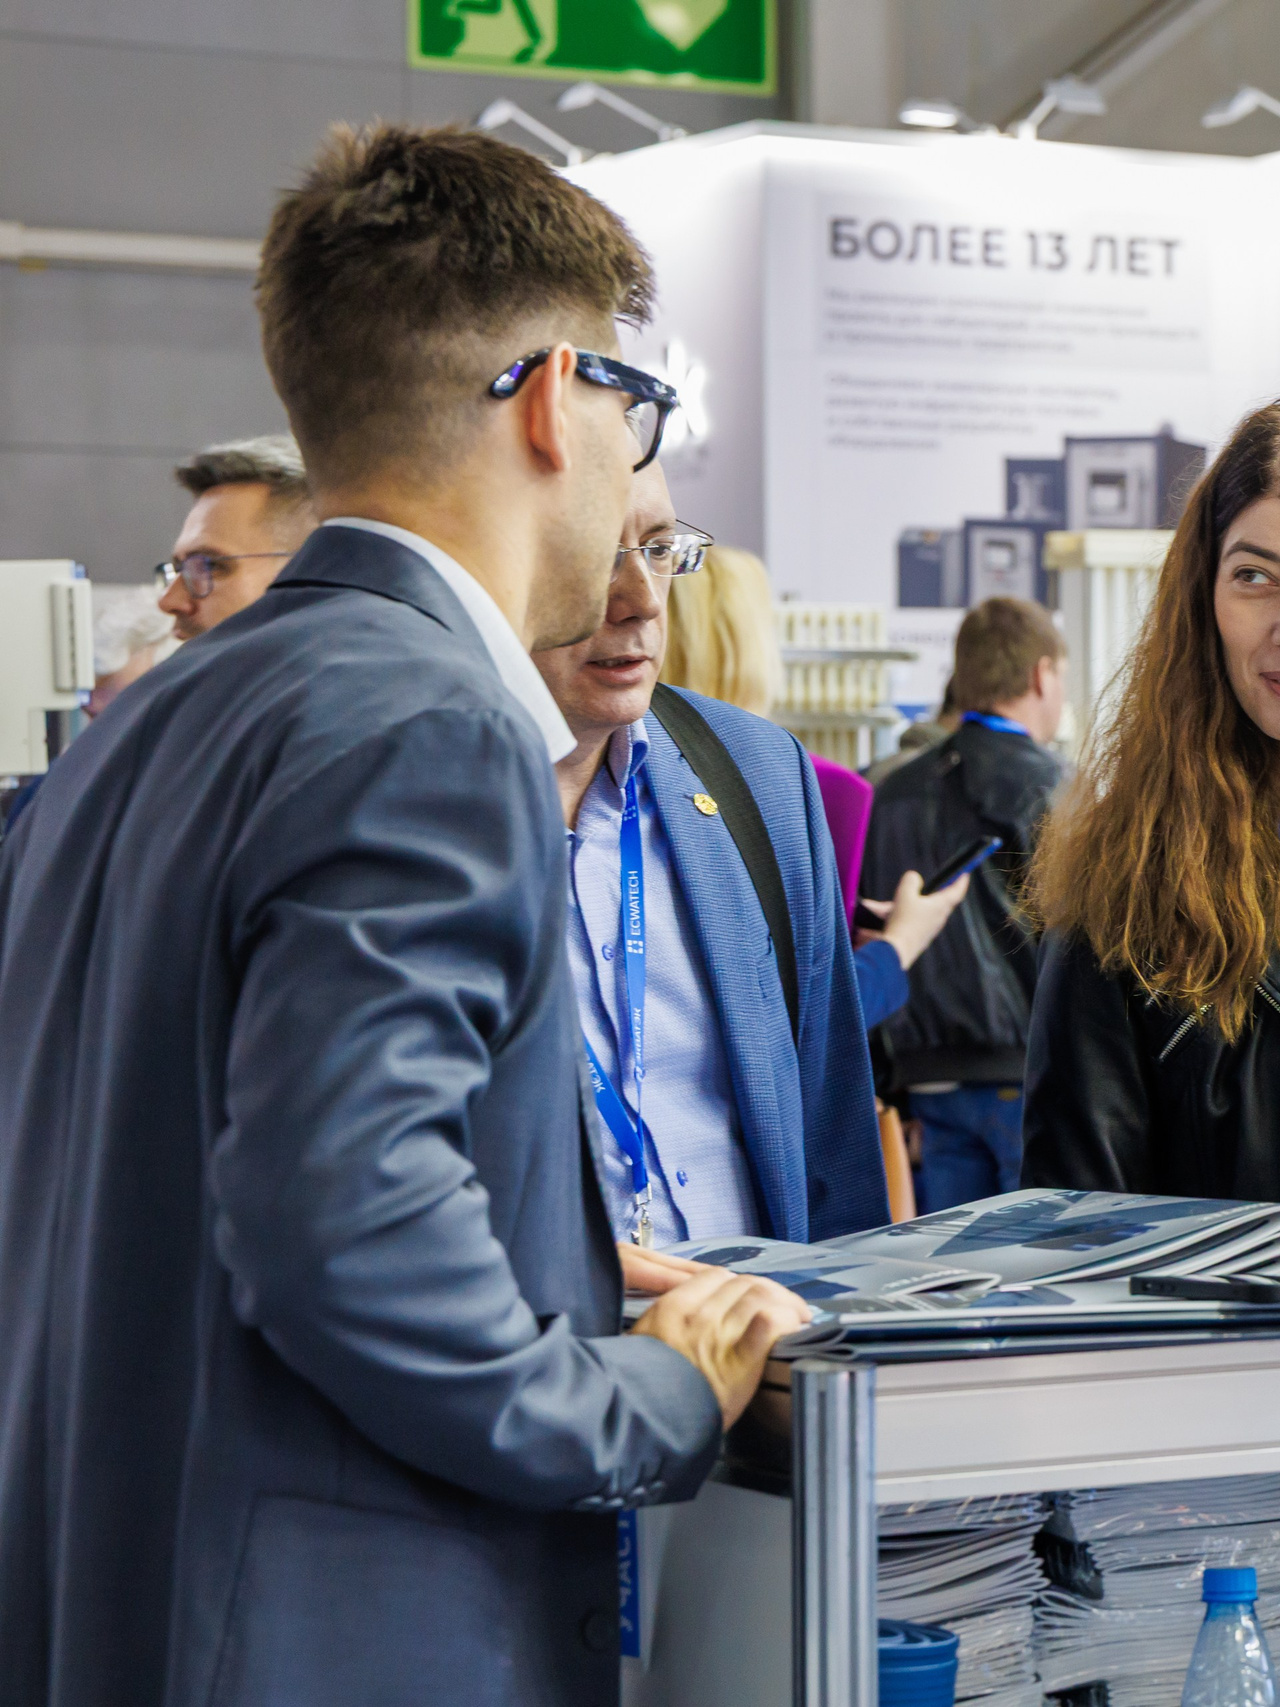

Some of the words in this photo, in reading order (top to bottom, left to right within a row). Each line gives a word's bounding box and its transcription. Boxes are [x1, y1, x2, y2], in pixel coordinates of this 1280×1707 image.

[828, 217, 1007, 268] БОЛЕЕ
[1026, 230, 1068, 272] 13
[1085, 235, 1182, 277] ЛЕТ
[627, 870, 641, 936] ECWATECH
